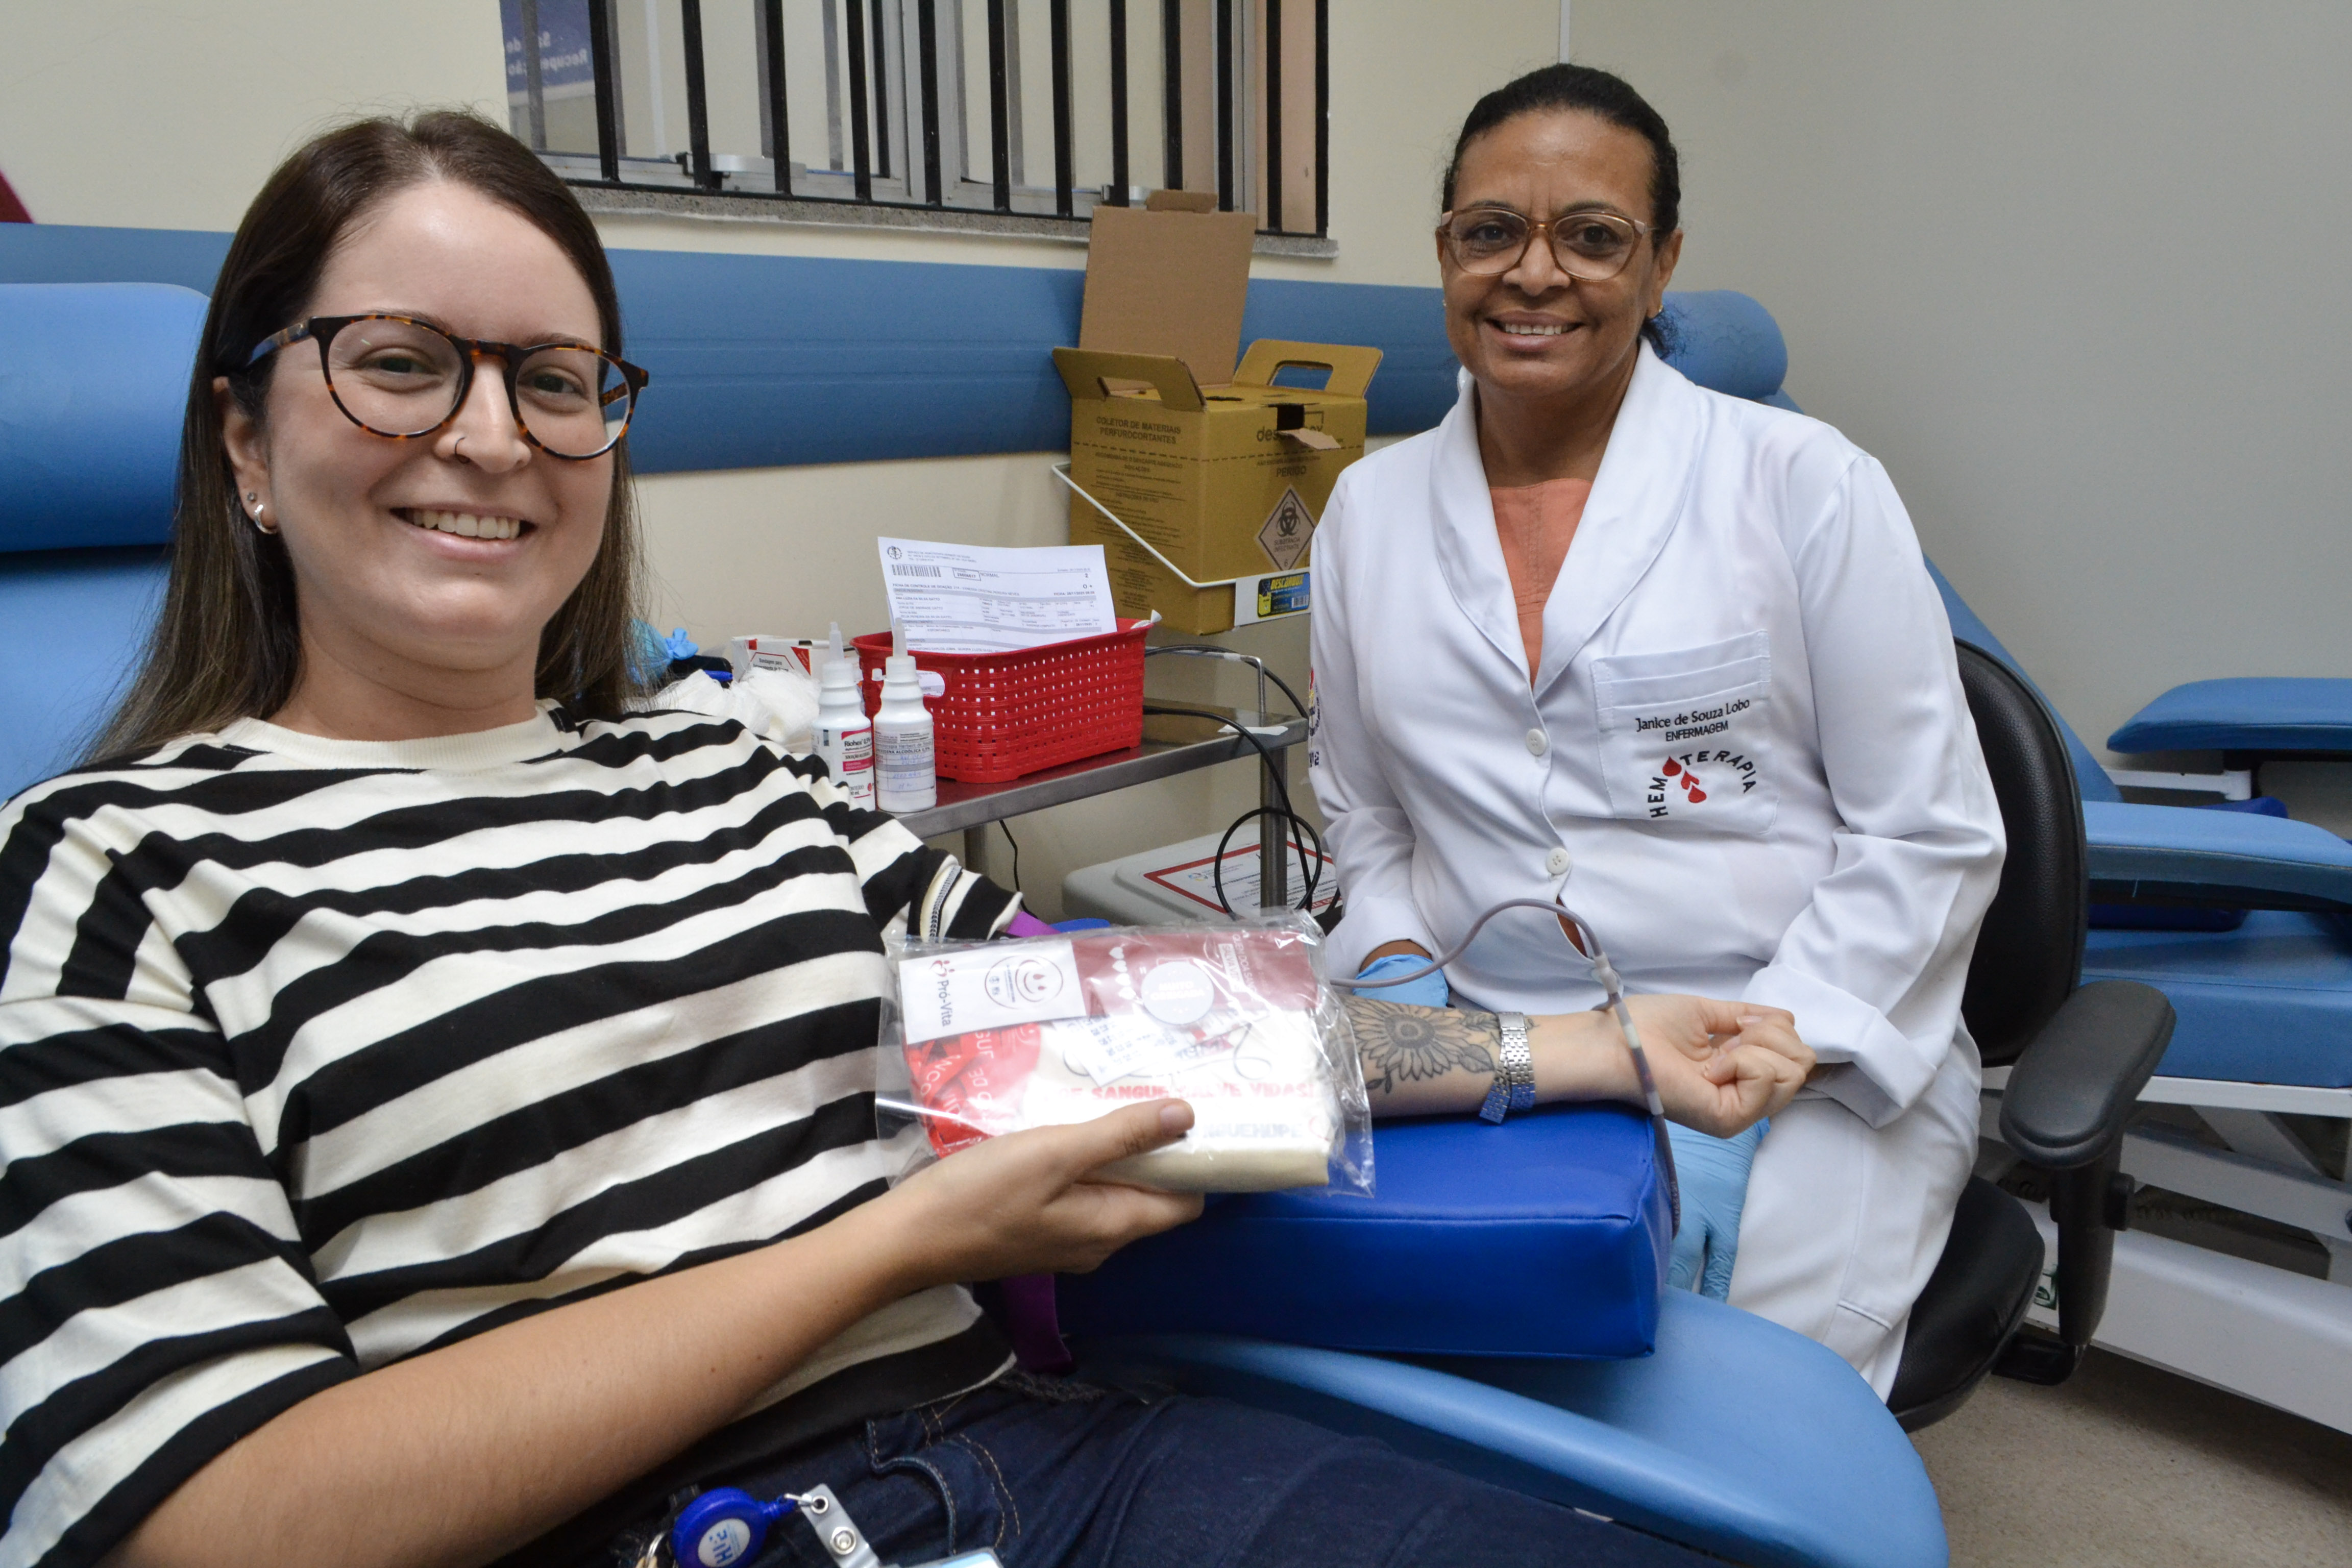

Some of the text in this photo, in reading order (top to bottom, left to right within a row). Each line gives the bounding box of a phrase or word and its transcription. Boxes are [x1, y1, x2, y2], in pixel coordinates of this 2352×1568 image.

[1096, 416, 1181, 434] COLETOR DE MATERIAIS
[1100, 427, 1176, 444] PERFUROCORTANTES
[1277, 465, 1307, 478] PERIGO
[1635, 699, 1750, 732] Janice de Souza Lobo
[1665, 721, 1729, 742] ENFERMAGEM
[1238, 954, 1250, 971] DOA
[937, 979, 953, 1027] Pró-Vita
[1091, 1085, 1169, 1100] SANGUE
